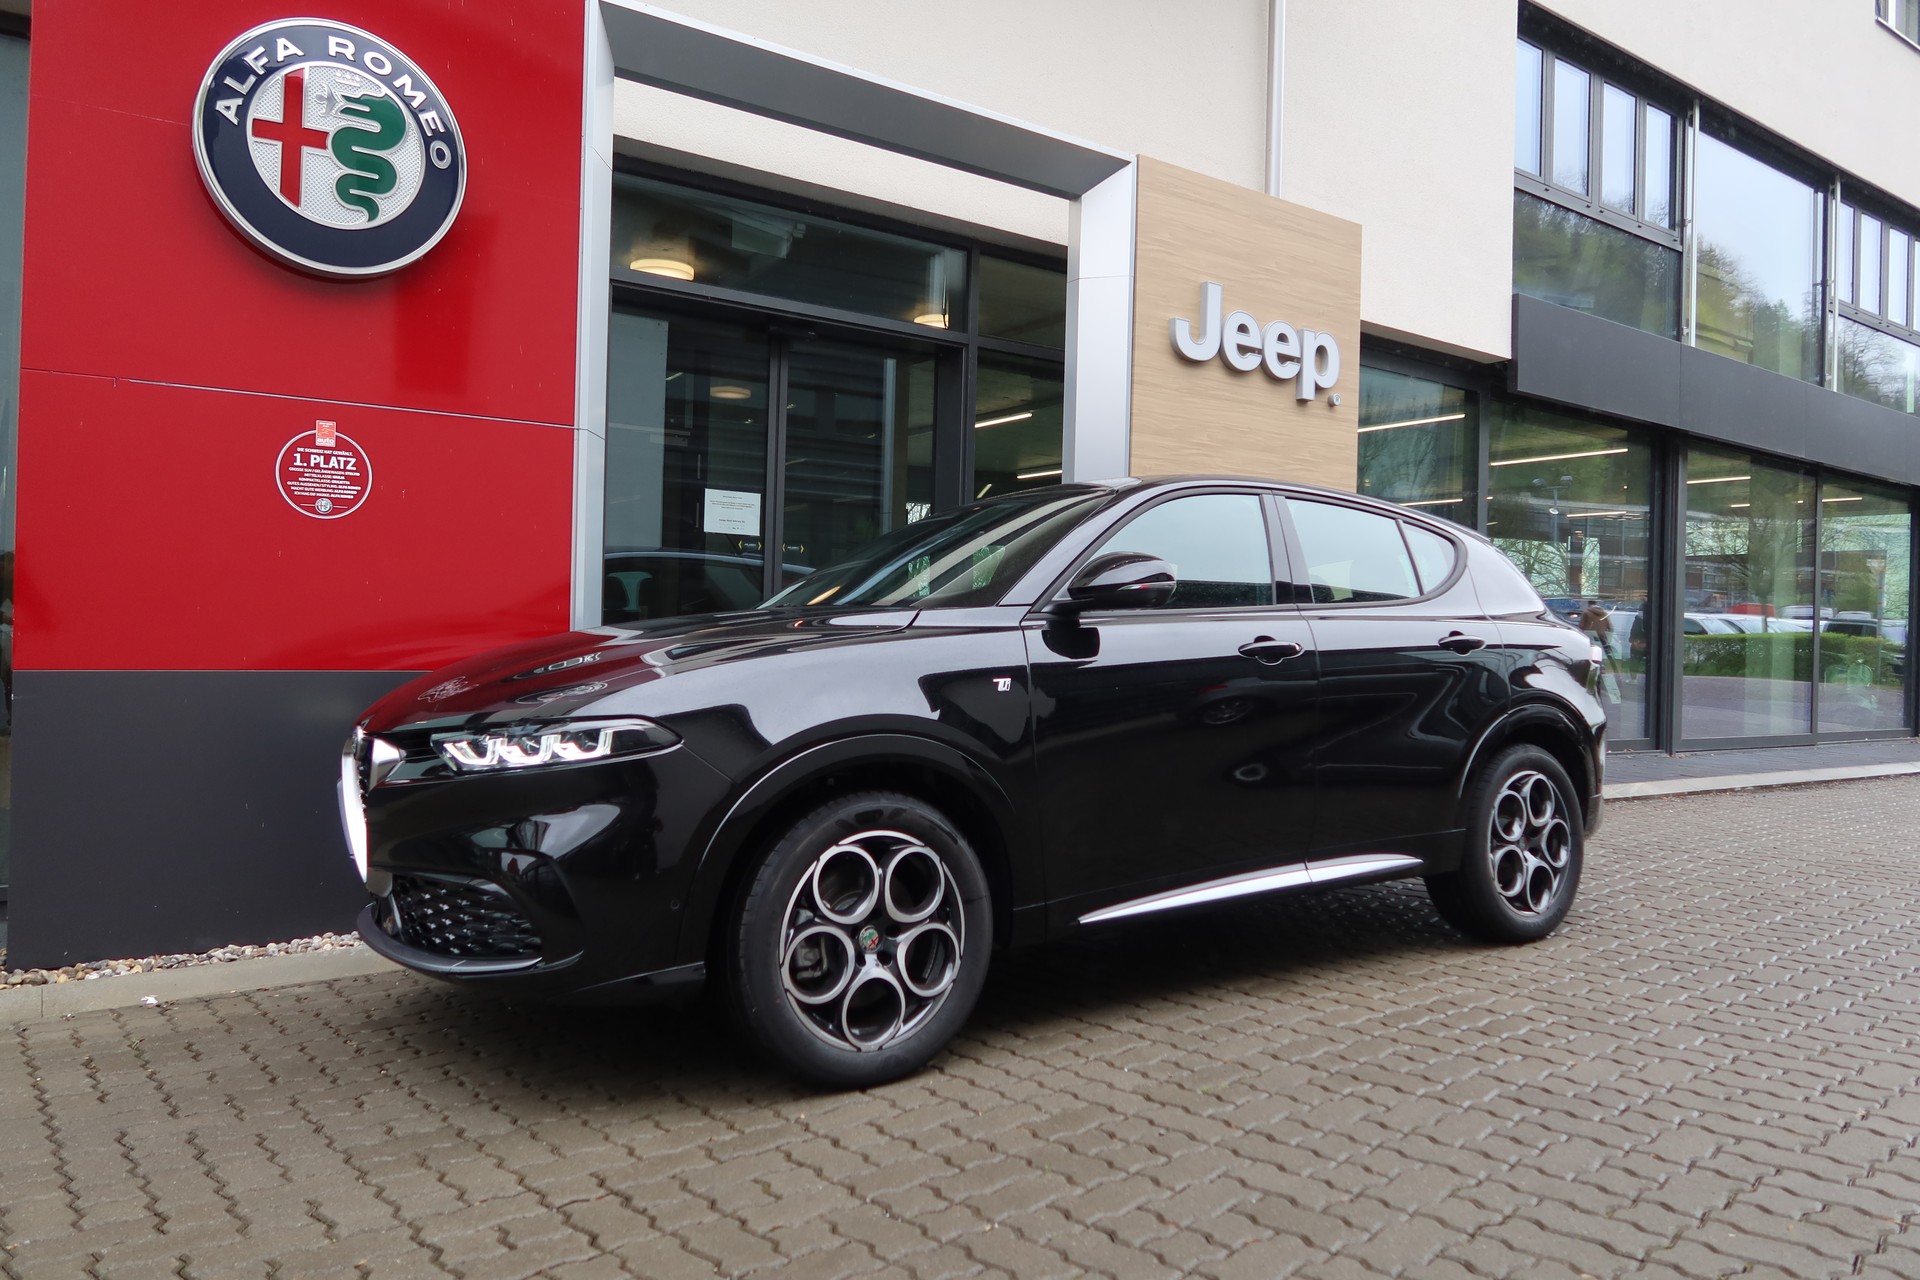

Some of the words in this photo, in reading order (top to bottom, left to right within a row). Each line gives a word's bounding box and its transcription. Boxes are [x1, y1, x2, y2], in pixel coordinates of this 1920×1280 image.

[215, 37, 304, 126] ALFA
[328, 35, 452, 170] ROMEO
[1168, 281, 1341, 401] Jeep
[293, 453, 307, 467] 1.
[310, 454, 357, 471] PLATZ
